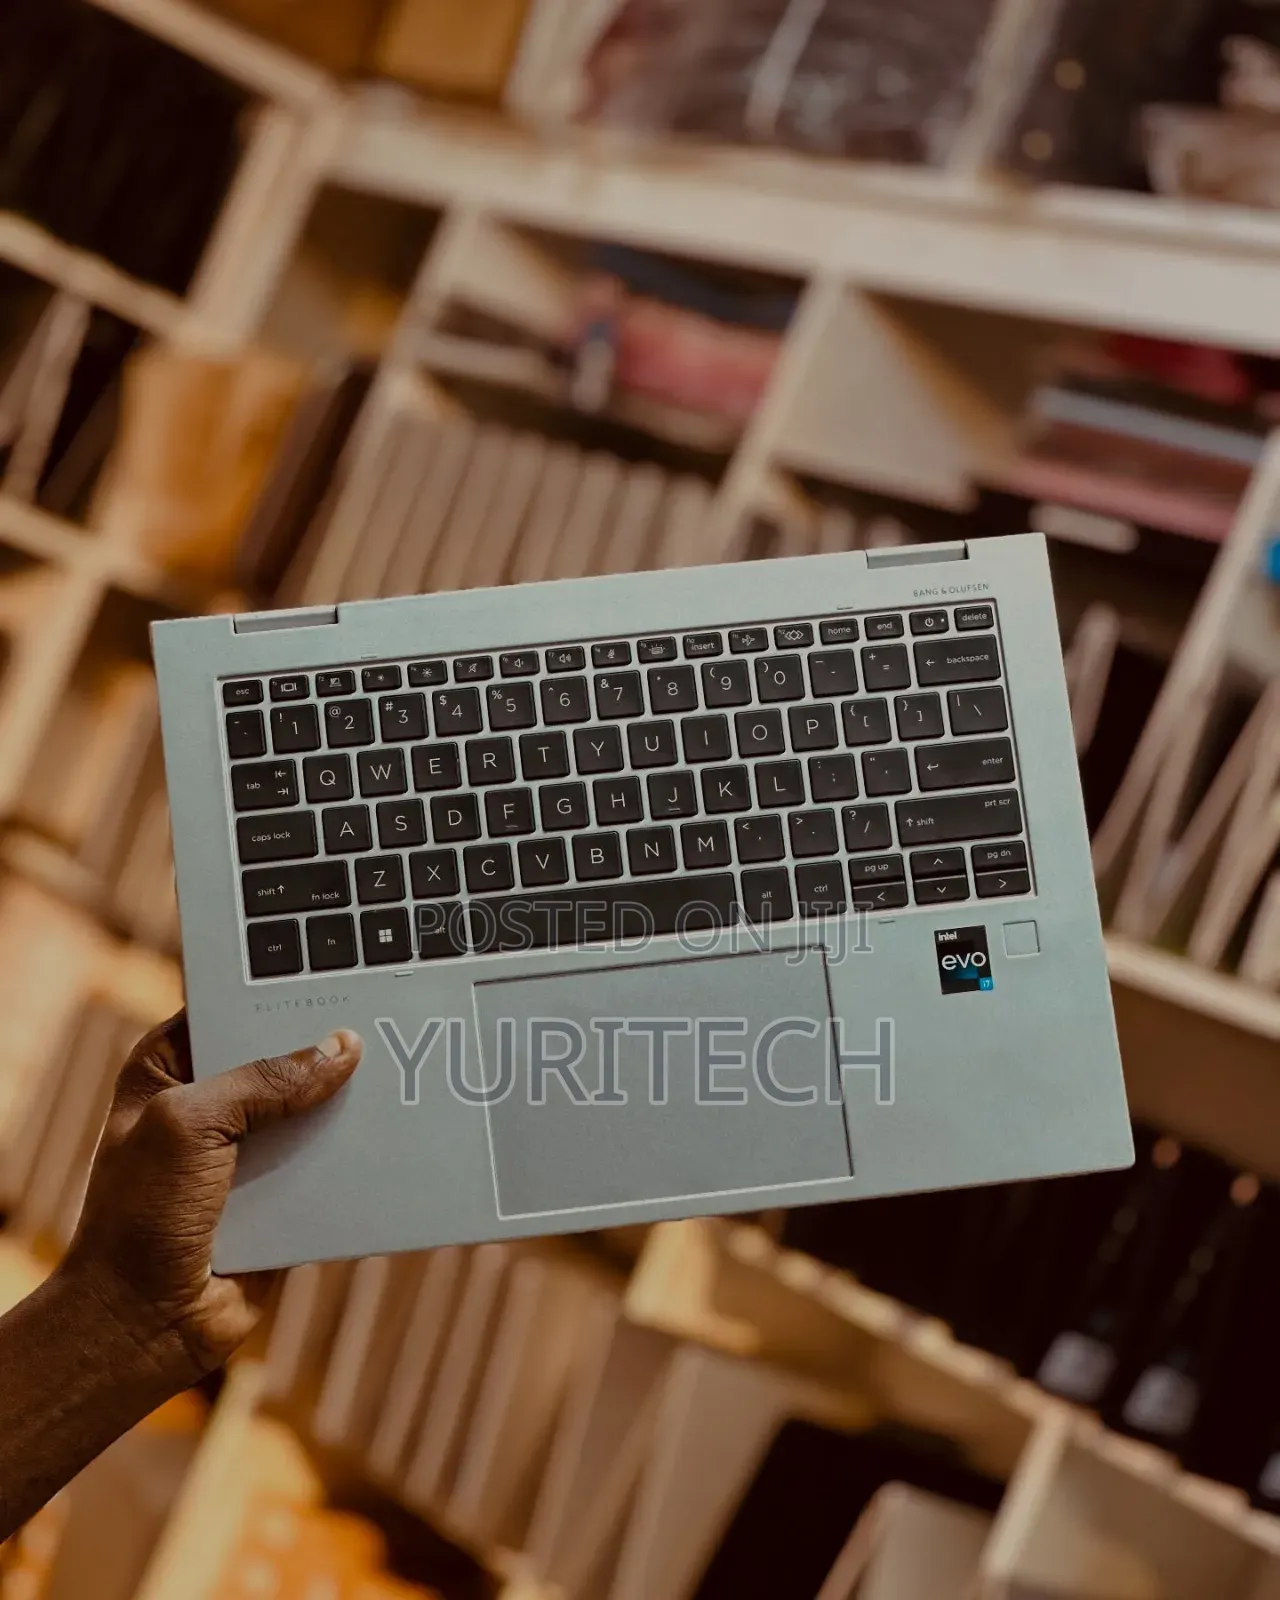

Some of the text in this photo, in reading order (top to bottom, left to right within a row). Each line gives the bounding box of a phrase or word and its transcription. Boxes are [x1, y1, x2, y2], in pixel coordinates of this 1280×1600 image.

[913, 587, 939, 598] BANG
[949, 583, 990, 594] OLUFSEN
[962, 612, 988, 622] delete
[828, 626, 852, 636] home
[876, 622, 893, 631] end
[692, 642, 715, 651] insert
[946, 653, 990, 665] backspace
[600, 679, 610, 689] &
[667, 681, 679, 696] 8
[720, 676, 732, 691] 9
[236, 688, 250, 696] esc
[491, 690, 503, 700] %
[613, 686, 623, 701] 7
[385, 701, 394, 712] #
[439, 695, 448, 706] $
[506, 698, 517, 713] 5
[559, 692, 571, 708] 6
[329, 705, 342, 718] @
[398, 710, 409, 724] 3
[452, 704, 463, 718] 4
[292, 721, 299, 735] 1
[344, 716, 355, 730] 2
[806, 719, 819, 735] P
[704, 730, 709, 746] I
[752, 725, 768, 741] O
[591, 741, 605, 757] Y
[645, 735, 659, 752] U
[482, 752, 498, 769] R
[537, 746, 550, 763] T
[982, 757, 1004, 766] enter
[370, 764, 392, 781] W
[429, 757, 443, 774] E
[319, 770, 336, 786] Q
[773, 776, 787, 792] L
[246, 782, 261, 790] tab
[718, 781, 733, 798] K
[611, 792, 626, 809] H
[667, 787, 678, 803] J
[556, 798, 572, 815] G
[984, 798, 1011, 808] prt scr
[447, 810, 463, 826] D
[503, 803, 515, 820] F
[849, 810, 857, 820] ?
[395, 815, 408, 832] S
[917, 817, 935, 826] shift
[252, 831, 291, 843] caps lock
[340, 821, 355, 838] A
[644, 842, 660, 858] N
[698, 836, 715, 853] M
[536, 854, 550, 870] V
[590, 848, 605, 864] B
[987, 849, 1012, 860] pg dn
[427, 865, 441, 882] X
[481, 859, 496, 876] C
[865, 863, 889, 873] pg up
[373, 870, 386, 888] Z
[258, 888, 277, 897] shift
[311, 892, 340, 901] fn lock
[762, 891, 773, 899] alt
[814, 885, 828, 893] ctrl
[327, 938, 336, 946] fn
[938, 931, 958, 942] intel
[268, 944, 282, 952] ctrl
[941, 952, 987, 971] evo
[982, 979, 991, 988] i7
[254, 995, 350, 1013] ELITEBOOK
